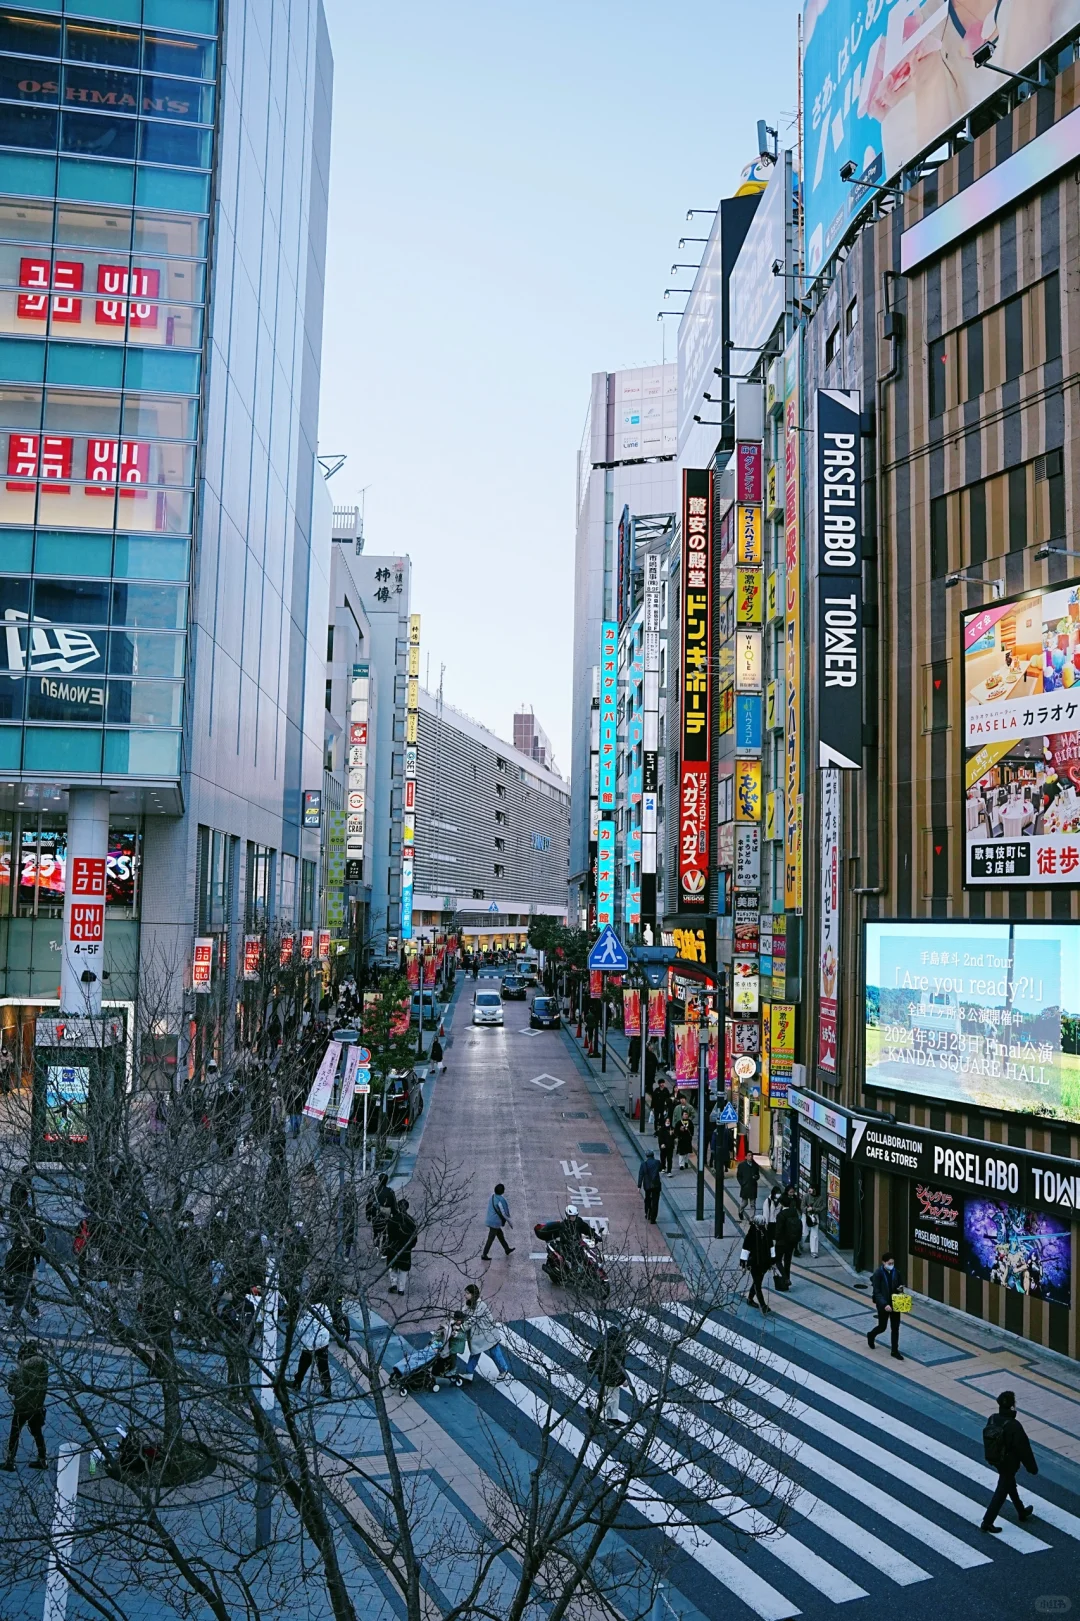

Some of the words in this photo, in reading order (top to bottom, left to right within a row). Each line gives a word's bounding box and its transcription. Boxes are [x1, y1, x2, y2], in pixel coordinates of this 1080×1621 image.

[18, 80, 190, 114] OSHMAN'S
[823, 432, 856, 568] PASELABO
[744, 508, 758, 561] タウンハウジング
[968, 614, 992, 637] ママ会
[824, 594, 857, 688] TOWER
[970, 717, 1017, 734] PASELA
[1023, 702, 1078, 726] カラオケ
[745, 711, 753, 747] ハウスコム
[742, 762, 758, 772] 2F
[348, 825, 363, 833] CRAB
[682, 772, 699, 865] ベガスベガス
[974, 846, 1027, 860] 歌舞伎町に
[1037, 846, 1079, 875] 徒歩
[77, 862, 103, 875] ユニ
[599, 830, 610, 923] カラオケ館
[787, 864, 796, 893] 6F
[986, 860, 1015, 874] 3店舗
[75, 878, 102, 891] クロ
[74, 908, 100, 921] UNI
[74, 924, 101, 938] QLO
[74, 944, 100, 955] 4-5F
[920, 950, 960, 967] 手島章斗
[964, 953, 984, 968] 2nd
[987, 954, 1013, 969] Tour
[934, 978, 964, 997] you
[888, 1045, 936, 1069] KANDA
[940, 1054, 1001, 1079] SQUARE
[1005, 1063, 1050, 1085] HALL
[866, 1130, 923, 1154] COLLABORATION
[866, 1145, 884, 1161] CAFE
[884, 1151, 890, 1162] &
[891, 1153, 918, 1168] STORES
[934, 1145, 1018, 1194] PASELABO
[914, 1228, 940, 1245] PASELABO
